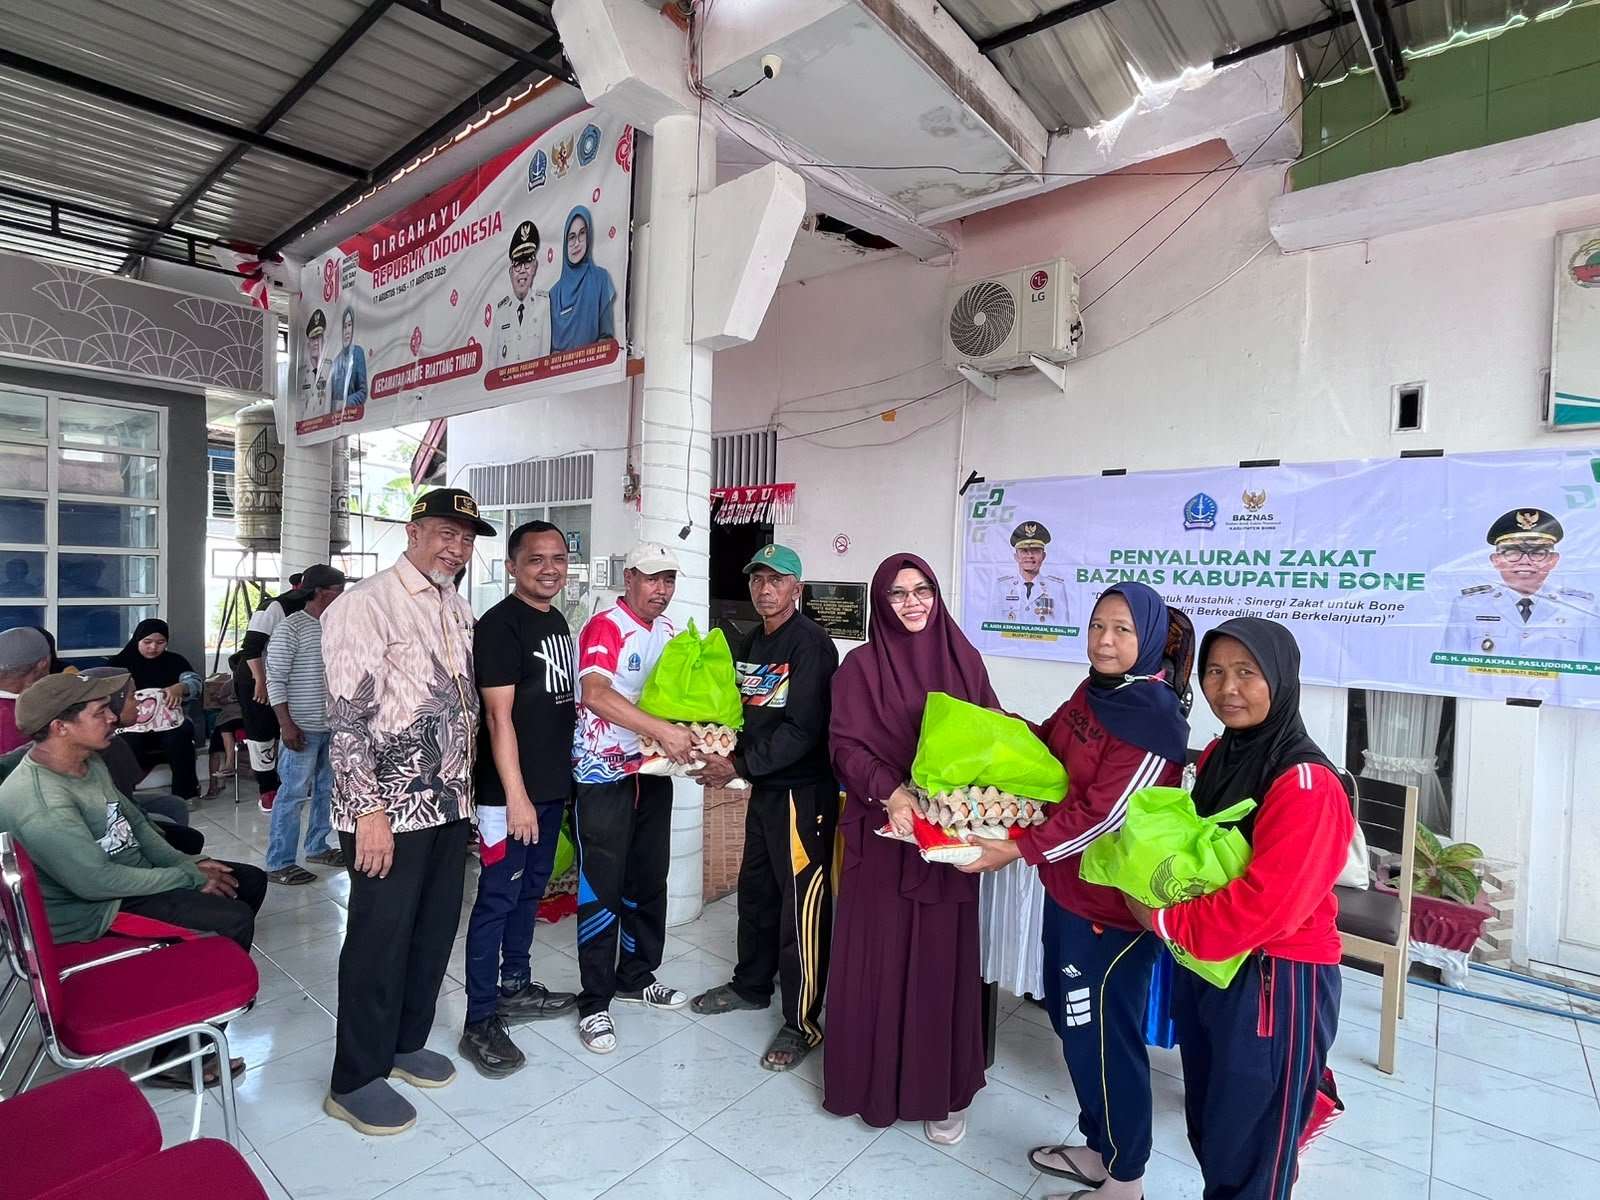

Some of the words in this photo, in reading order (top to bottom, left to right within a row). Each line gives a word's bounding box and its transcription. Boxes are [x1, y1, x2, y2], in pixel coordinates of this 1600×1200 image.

[373, 200, 460, 261] DIRGAHAYU
[372, 244, 427, 289] REPUBLIK
[428, 210, 502, 263] INDONESIA
[1032, 292, 1046, 302] LG
[455, 351, 477, 372] TIMUR
[1232, 513, 1274, 522] BAZNAS
[1110, 550, 1270, 566] PENYALURAN
[1279, 550, 1376, 567] ZAKAT
[1076, 568, 1165, 584] BAZNAS
[1172, 570, 1329, 588] KABUPATEN
[1338, 572, 1426, 591] BONE
[1185, 595, 1234, 605] Mustahik
[1244, 596, 1287, 608] Sinergi
[1290, 598, 1324, 608] Zakat
[1327, 600, 1364, 610] untuk
[1369, 600, 1405, 612] Bone
[1196, 607, 1262, 618] Berkeadilan
[1266, 610, 1288, 620] dan
[1518, 660, 1573, 670] PASLUDDIN,
